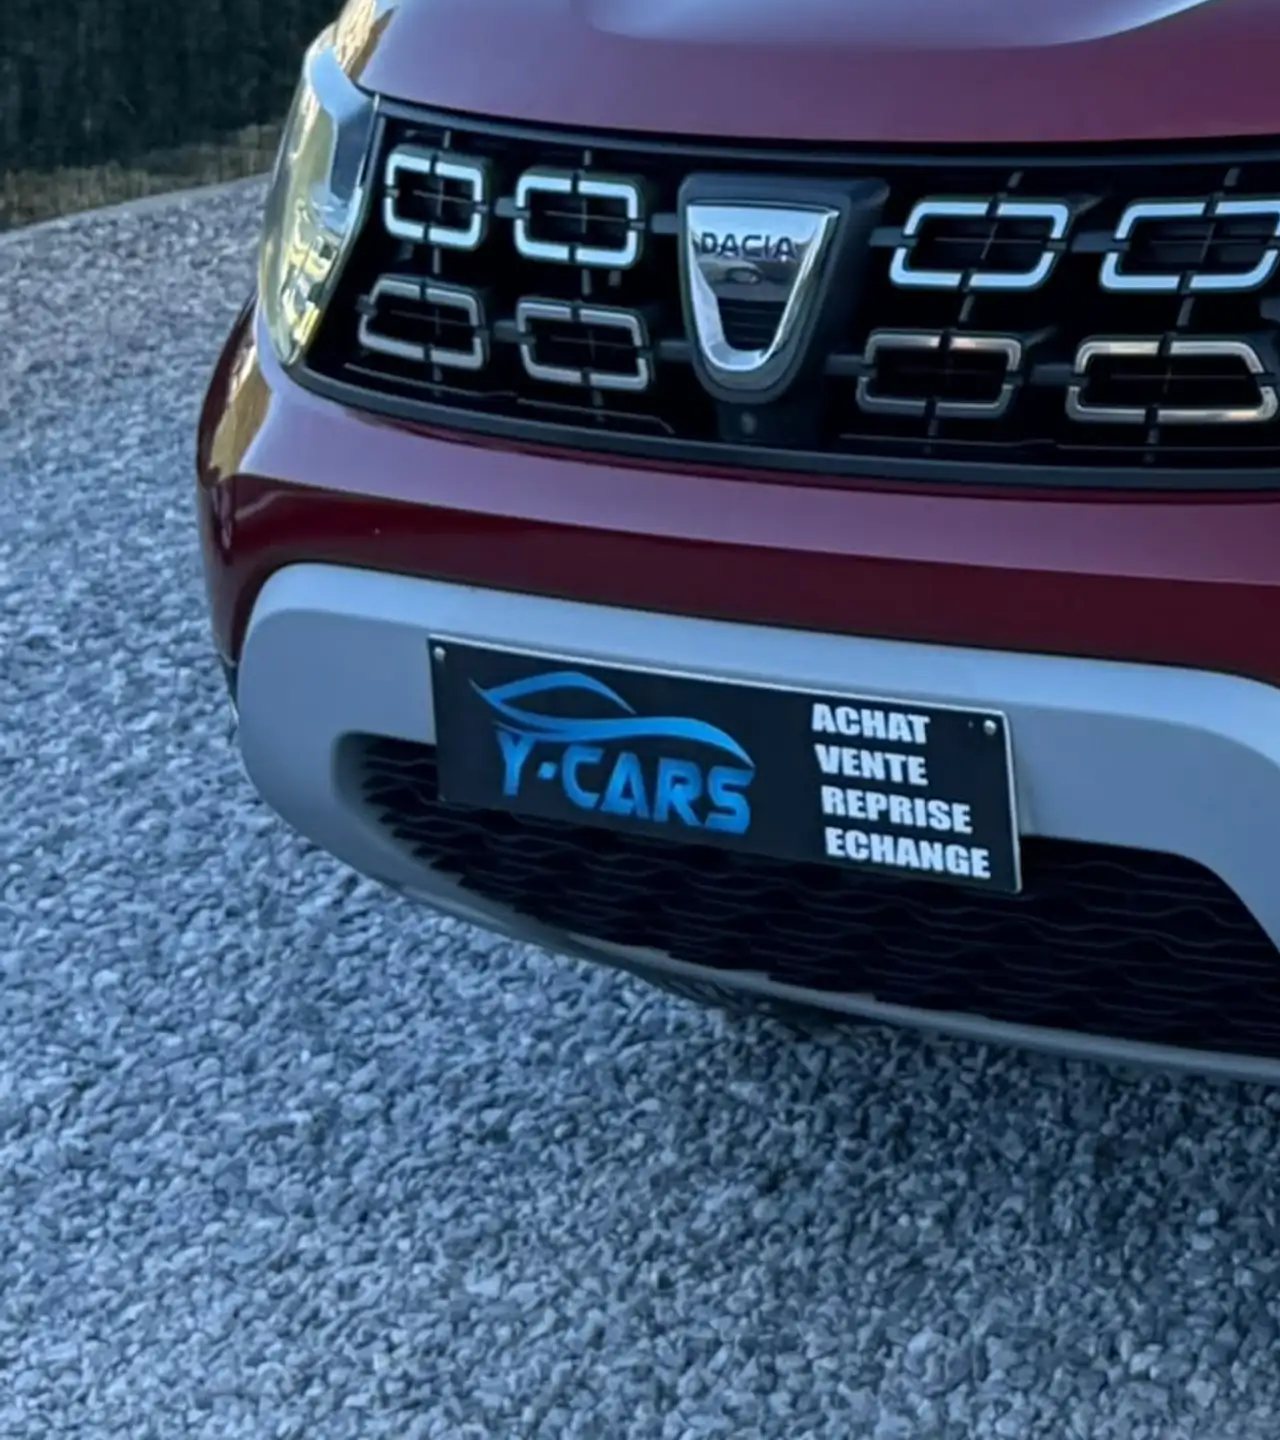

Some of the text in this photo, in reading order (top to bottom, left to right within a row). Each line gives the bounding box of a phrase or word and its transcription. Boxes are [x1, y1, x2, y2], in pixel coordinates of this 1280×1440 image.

[701, 231, 796, 259] DACIA
[812, 702, 931, 745] ACHAT
[495, 728, 757, 836] Y-CARS
[814, 742, 929, 787] VENTE
[821, 784, 974, 835] REPRISE
[825, 826, 992, 880] ECHANGE
